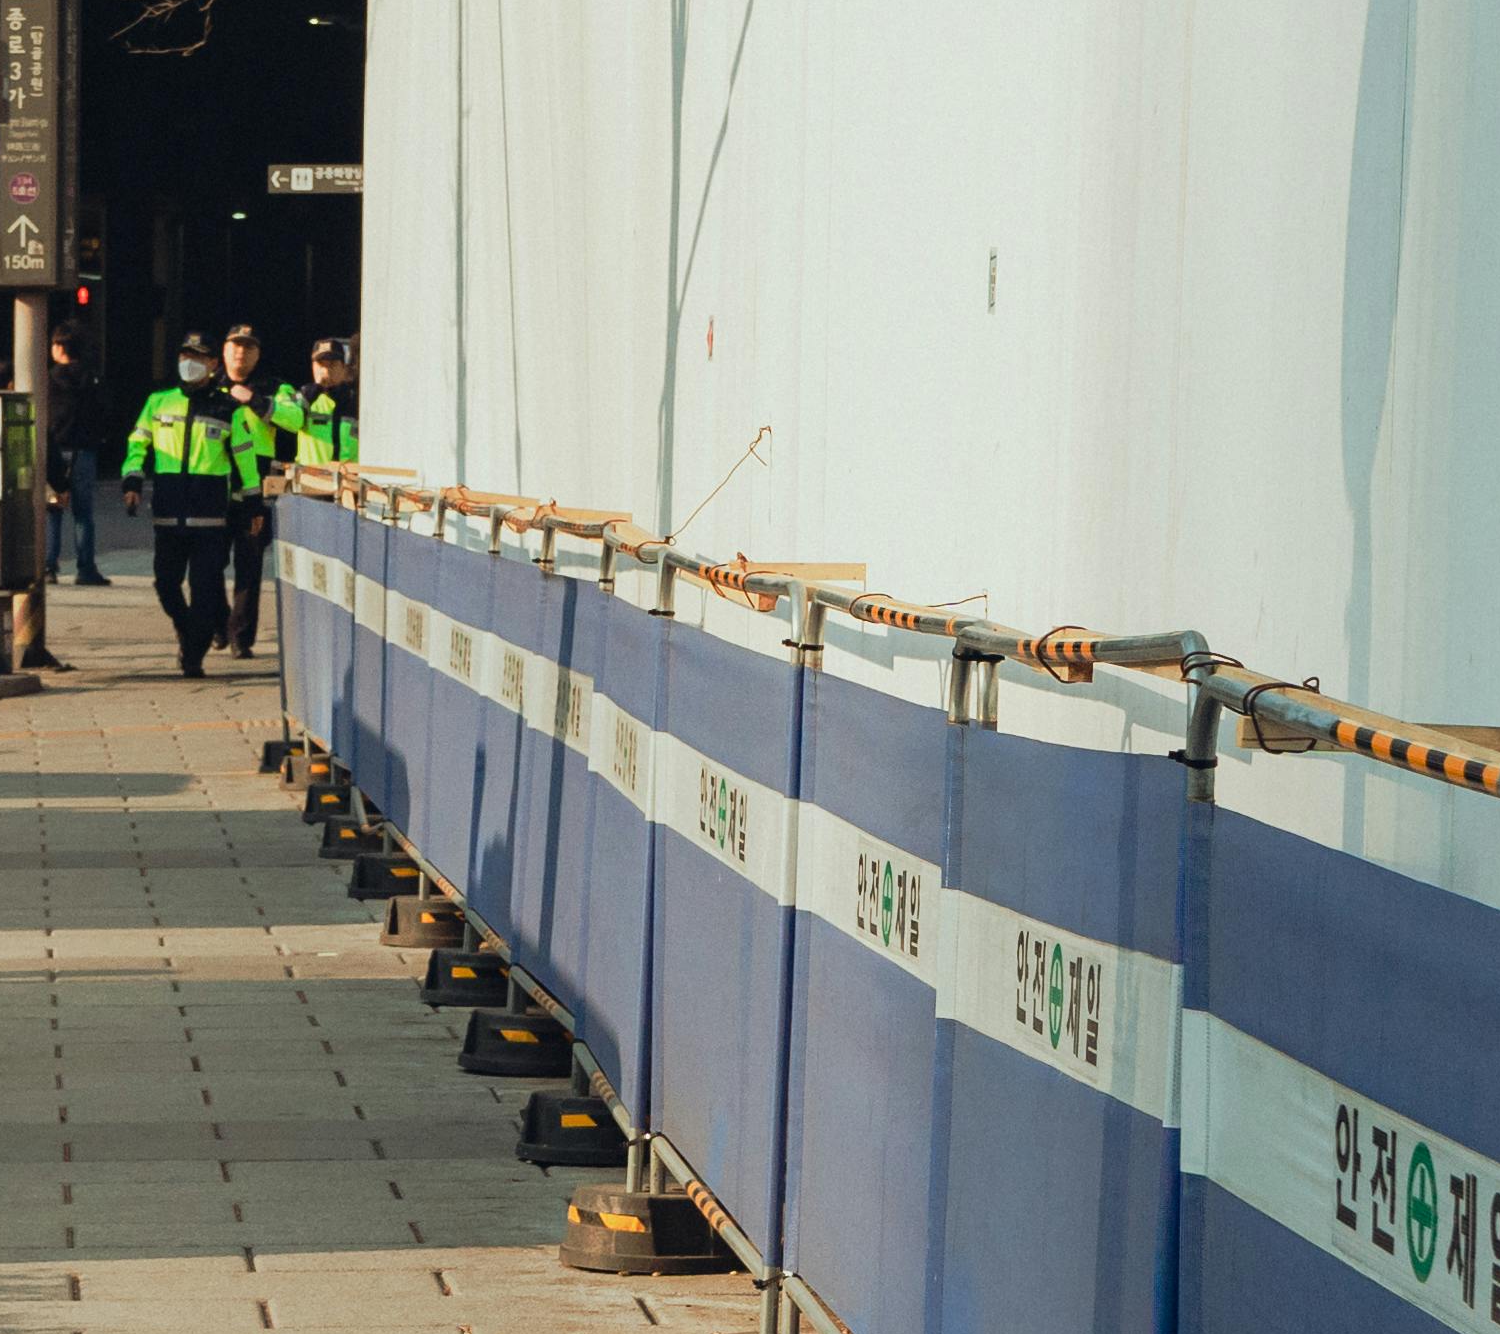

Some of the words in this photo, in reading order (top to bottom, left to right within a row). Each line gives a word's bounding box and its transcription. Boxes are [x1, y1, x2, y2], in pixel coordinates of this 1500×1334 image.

[4, 254, 45, 270] 150m
[699, 767, 718, 840] 안전
[728, 788, 748, 864] 제일
[856, 852, 881, 938] 안전
[895, 869, 921, 958] 제일
[1016, 930, 1047, 1036] 안전
[1066, 956, 1102, 1068] 제일
[1335, 1103, 1398, 1257] 안전
